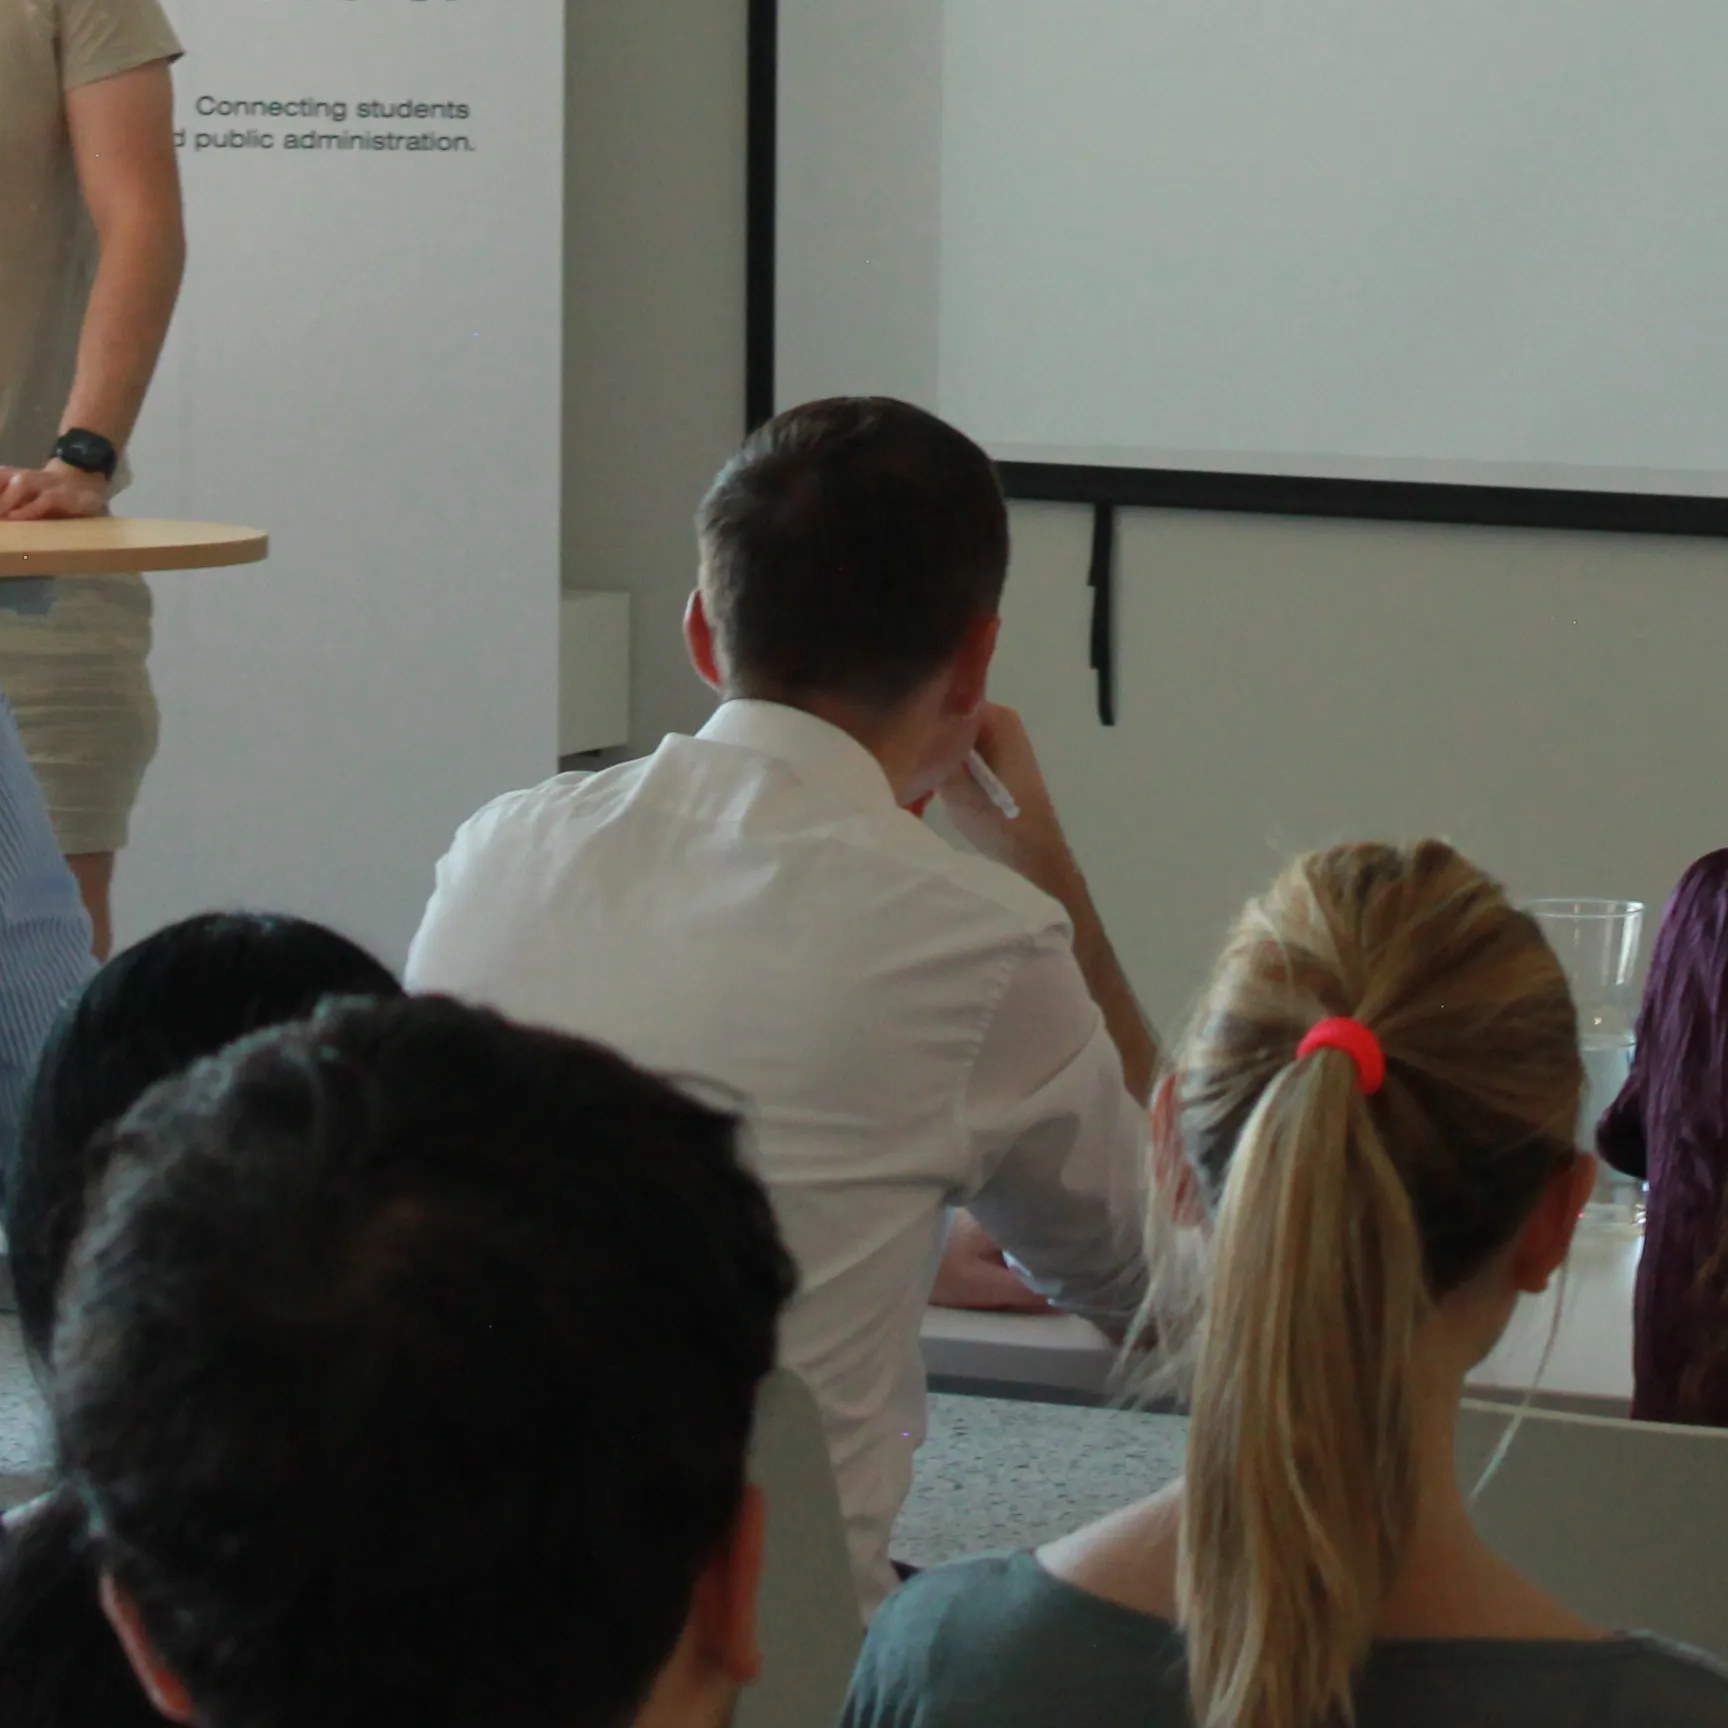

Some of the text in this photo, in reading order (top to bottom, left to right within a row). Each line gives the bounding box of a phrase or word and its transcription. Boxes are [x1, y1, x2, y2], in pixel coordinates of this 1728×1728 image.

[195, 94, 471, 122] Connecting students
[194, 128, 274, 152] public
[283, 129, 476, 153] administration.
